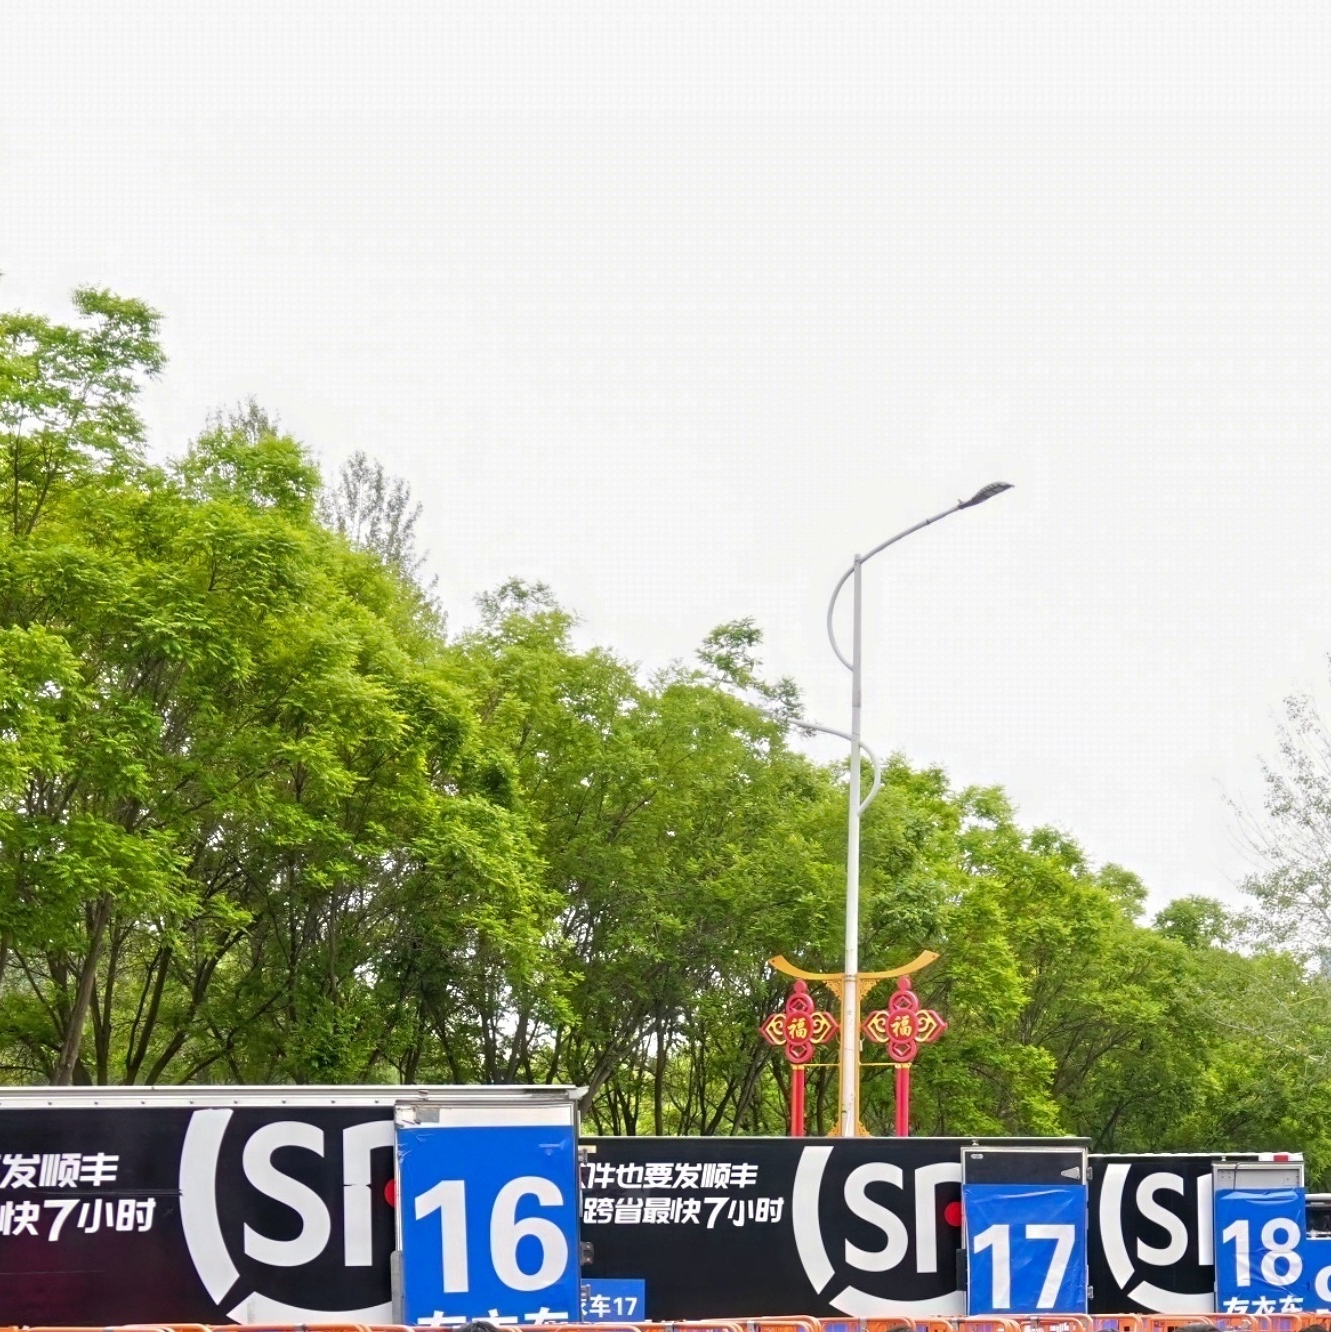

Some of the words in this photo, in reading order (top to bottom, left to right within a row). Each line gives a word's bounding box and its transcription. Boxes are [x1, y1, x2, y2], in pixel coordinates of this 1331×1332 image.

[787, 1017, 807, 1039] 福
[891, 1016, 912, 1038] 福
[579, 1162, 759, 1191] 件也要发顺丰
[583, 1197, 784, 1229] 跨省最快7小时
[414, 1176, 568, 1293] 16
[973, 1224, 1076, 1309] 17
[1222, 1217, 1303, 1288] 18
